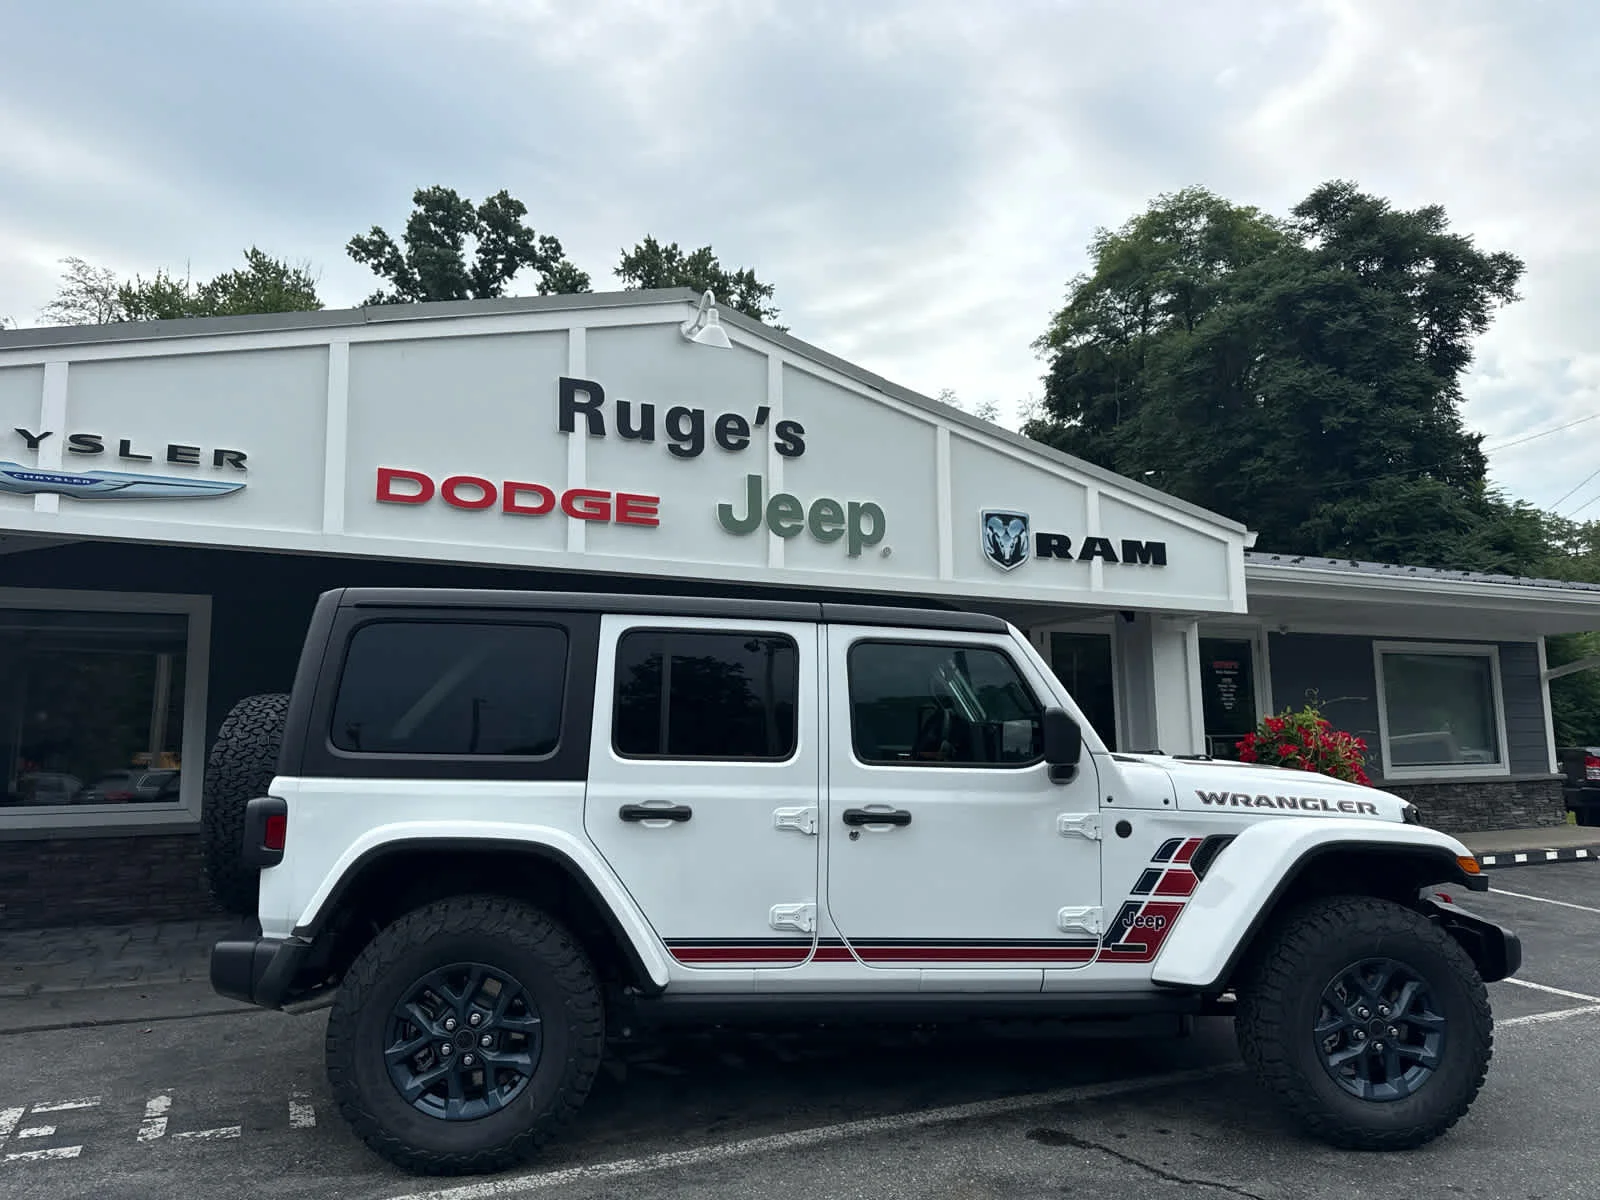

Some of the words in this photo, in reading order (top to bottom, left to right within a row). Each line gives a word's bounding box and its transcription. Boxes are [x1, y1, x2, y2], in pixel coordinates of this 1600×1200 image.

[558, 376, 806, 458] Ruge's
[14, 428, 248, 470] YSLER
[376, 467, 660, 526] DODGE
[717, 474, 887, 556] Jeep
[1035, 532, 1167, 566] RAM
[1195, 790, 1380, 815] WRANGLER
[1122, 912, 1167, 932] Jeep
